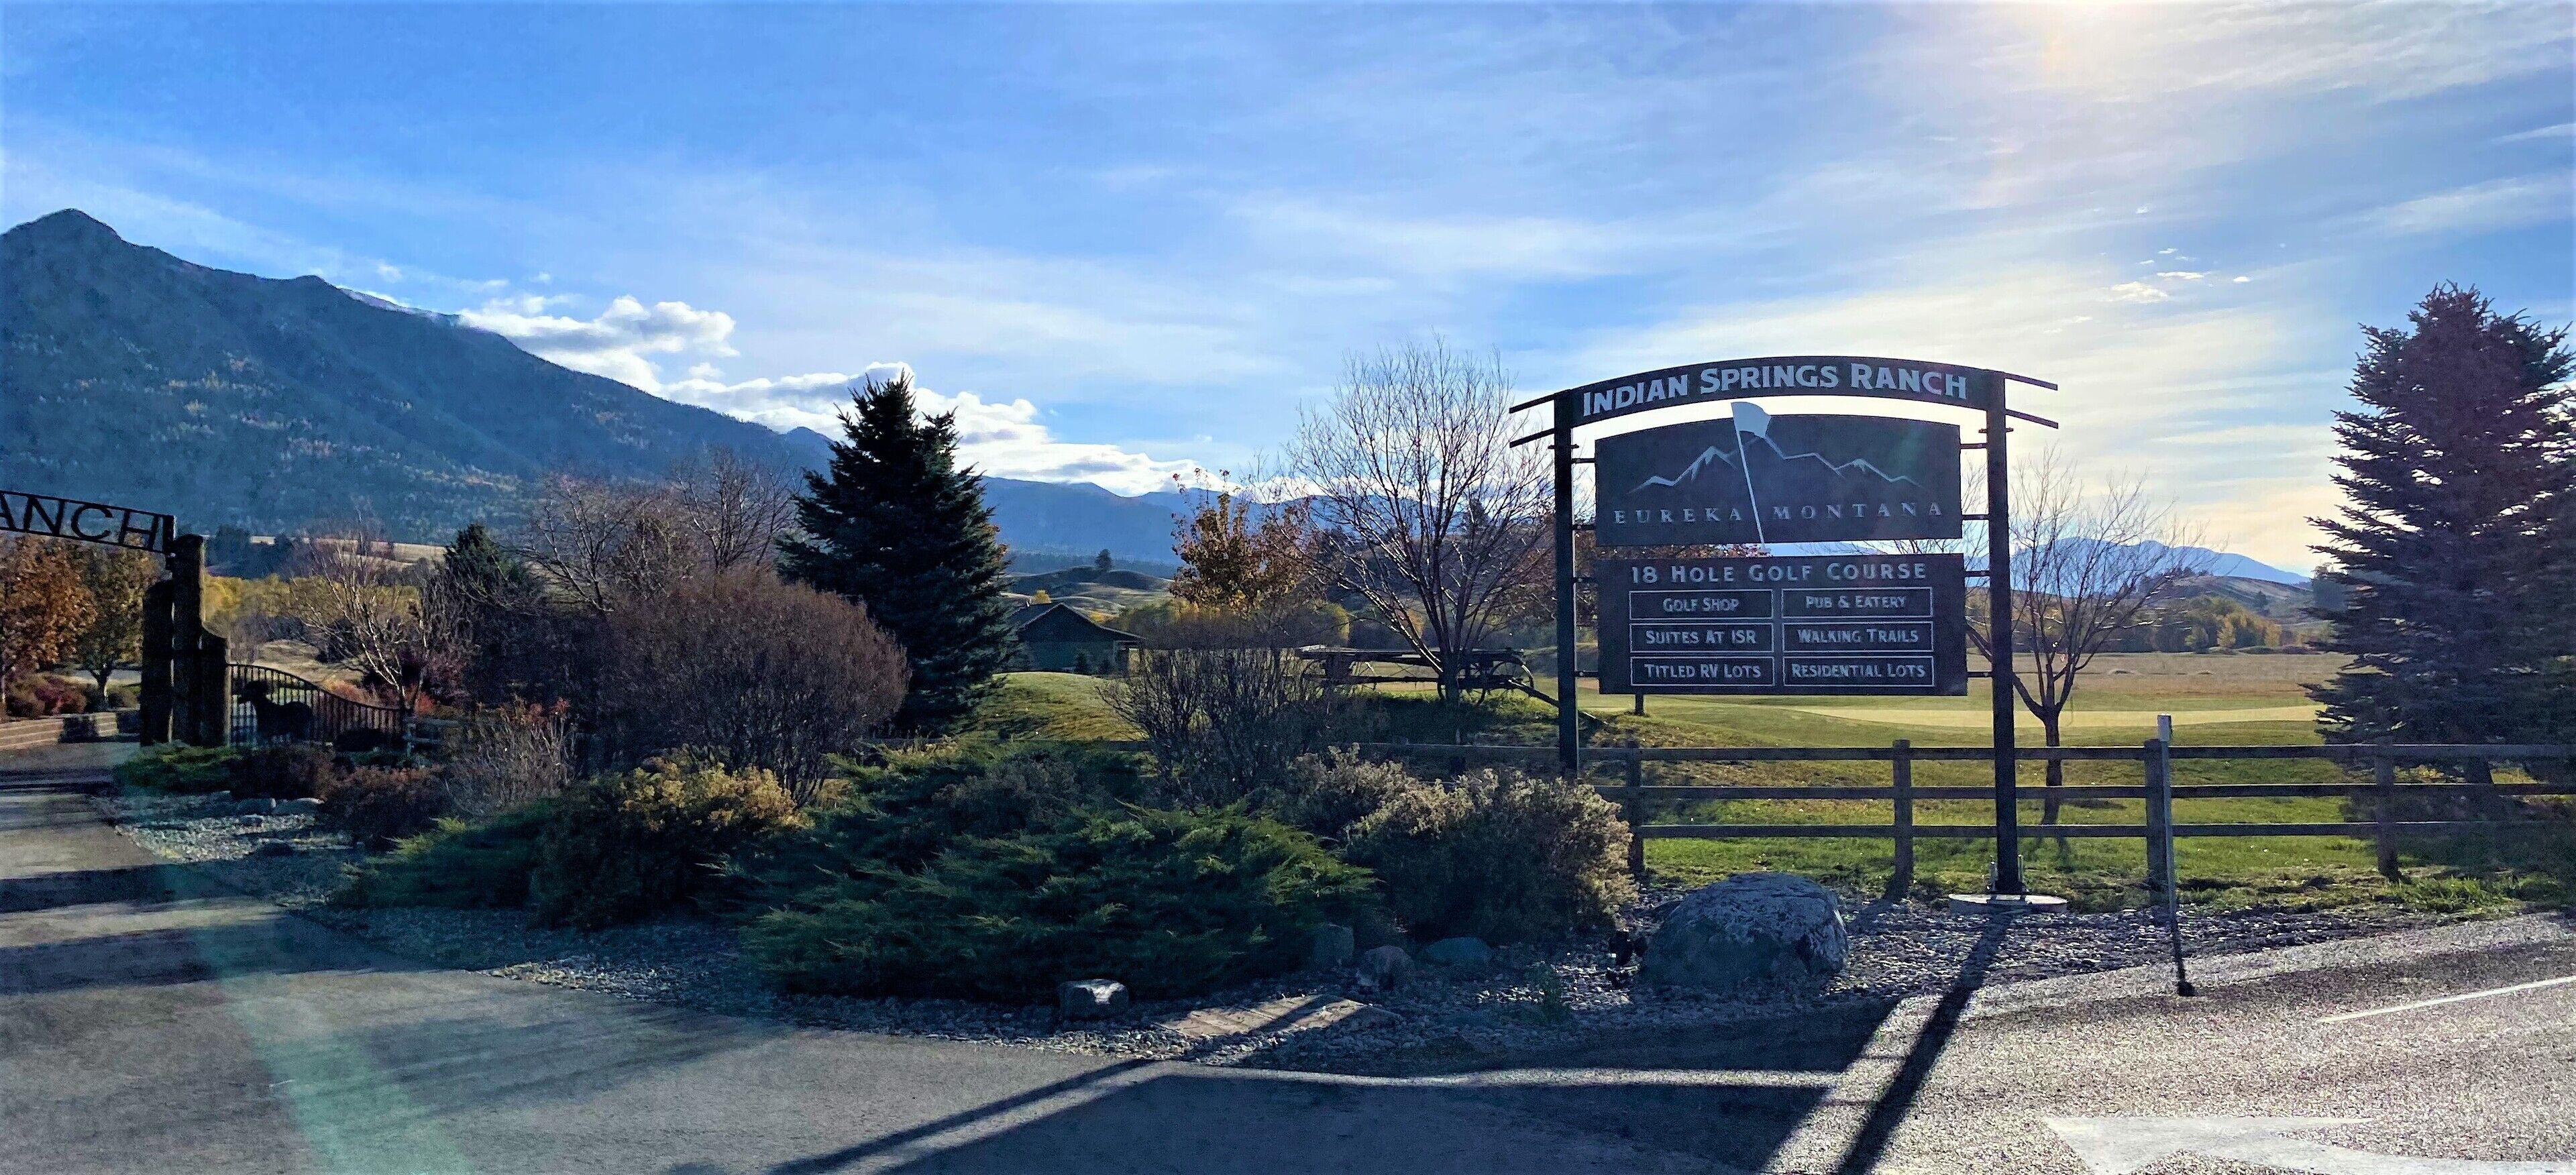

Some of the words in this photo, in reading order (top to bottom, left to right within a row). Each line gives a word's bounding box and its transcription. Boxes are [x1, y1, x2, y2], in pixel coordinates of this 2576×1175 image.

[1583, 374, 1688, 416] INDIAN
[1700, 366, 1839, 394] SPRINGS
[1851, 363, 1967, 399] RANCH
[1614, 508, 1741, 524] EUREKA
[1773, 503, 1942, 520] MONTANA
[1632, 566, 1658, 583] 18
[1671, 565, 1734, 582] HOLE
[1749, 564, 1811, 581] GOLF
[1827, 563, 1926, 580] COURSE
[1663, 598, 1698, 612] GOLF
[1703, 598, 1739, 612] SHOP
[1806, 596, 1833, 608] PUB
[1838, 596, 1849, 608] &
[1855, 595, 1907, 608] EATERY
[1646, 630, 1700, 644] SUITES
[1705, 630, 1725, 644] AT
[1731, 630, 1756, 644] ISR
[1798, 629, 1862, 643] WALKING
[1866, 628, 1919, 642] TRAILS
[1644, 664, 1695, 678] TITLED
[1701, 664, 1718, 678] RV
[1724, 664, 1761, 678] LOTS
[1791, 663, 1882, 678] RESIDENTIAL
[1887, 663, 1925, 678] LOTS
